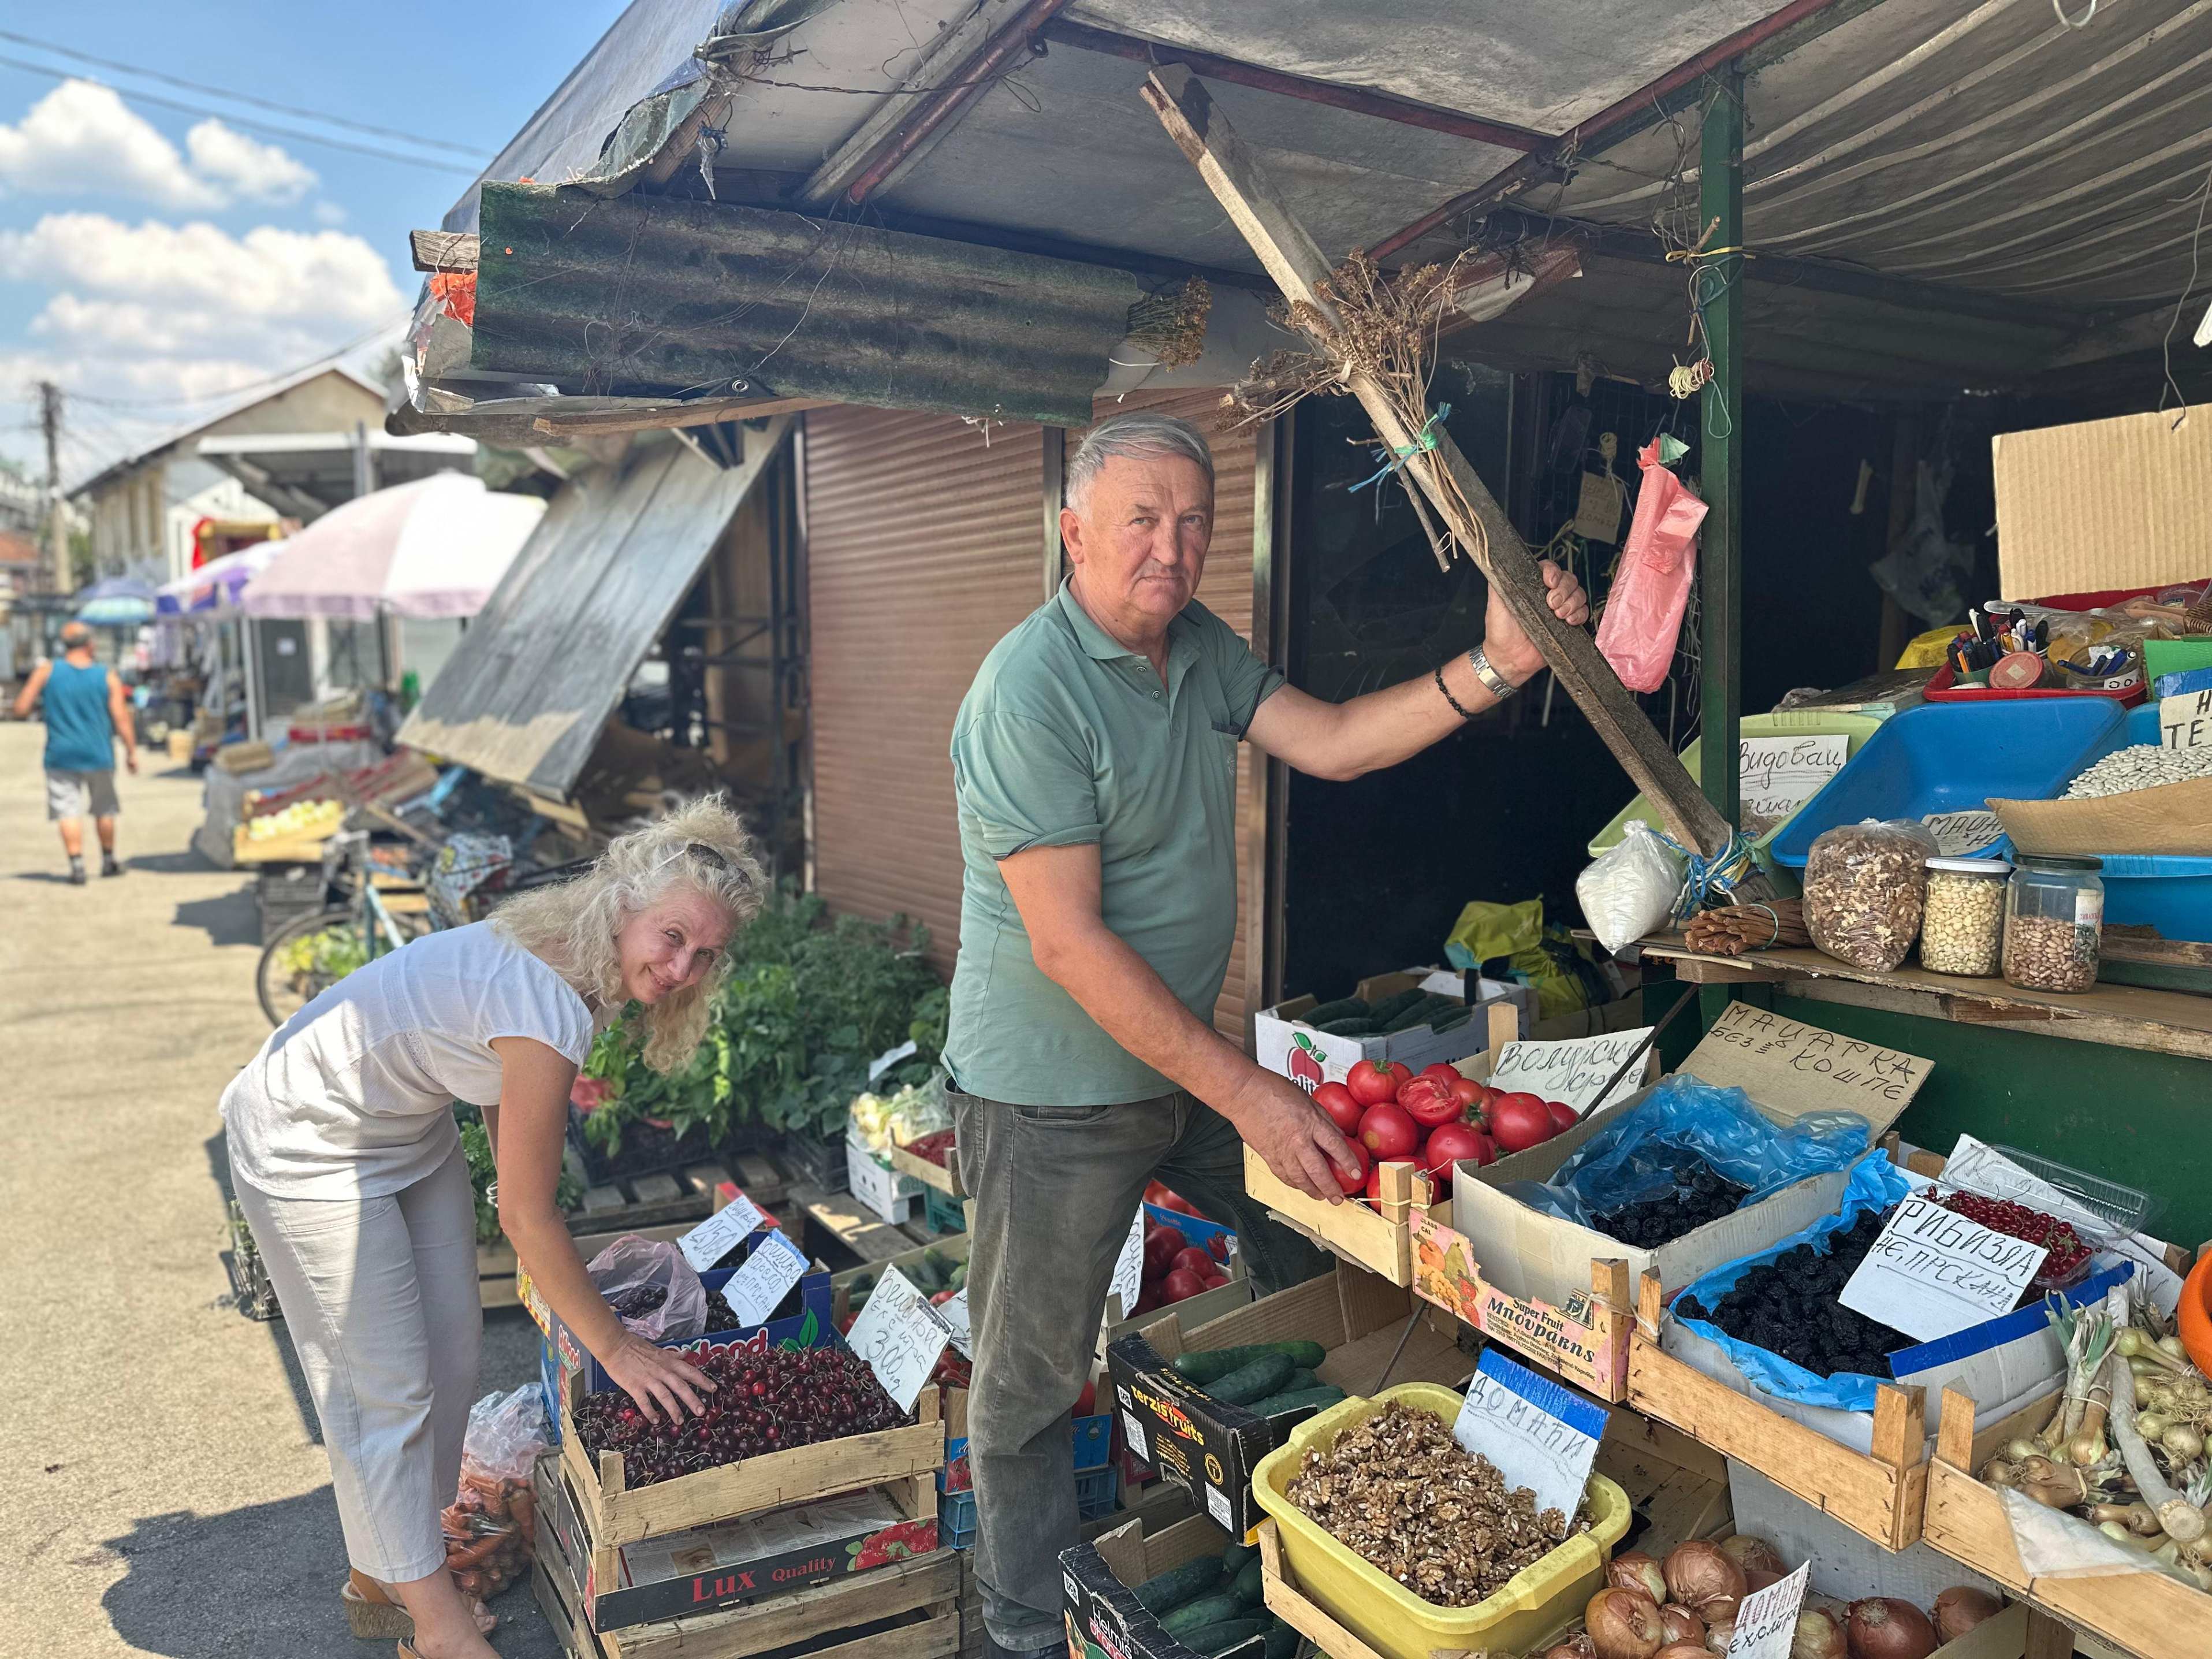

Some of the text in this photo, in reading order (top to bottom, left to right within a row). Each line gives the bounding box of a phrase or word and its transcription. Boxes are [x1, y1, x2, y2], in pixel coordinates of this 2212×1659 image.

[1710, 1026, 1754, 1047] БЕЗ
[1893, 1199, 2037, 1277] РИБИЗЛА
[1513, 1299, 1565, 1332] Super Fruit
[1467, 1376, 1589, 1460] ДОМАЋИ
[692, 1555, 837, 1602] Lux Quality
[1092, 1604, 1132, 1659] Helmis
